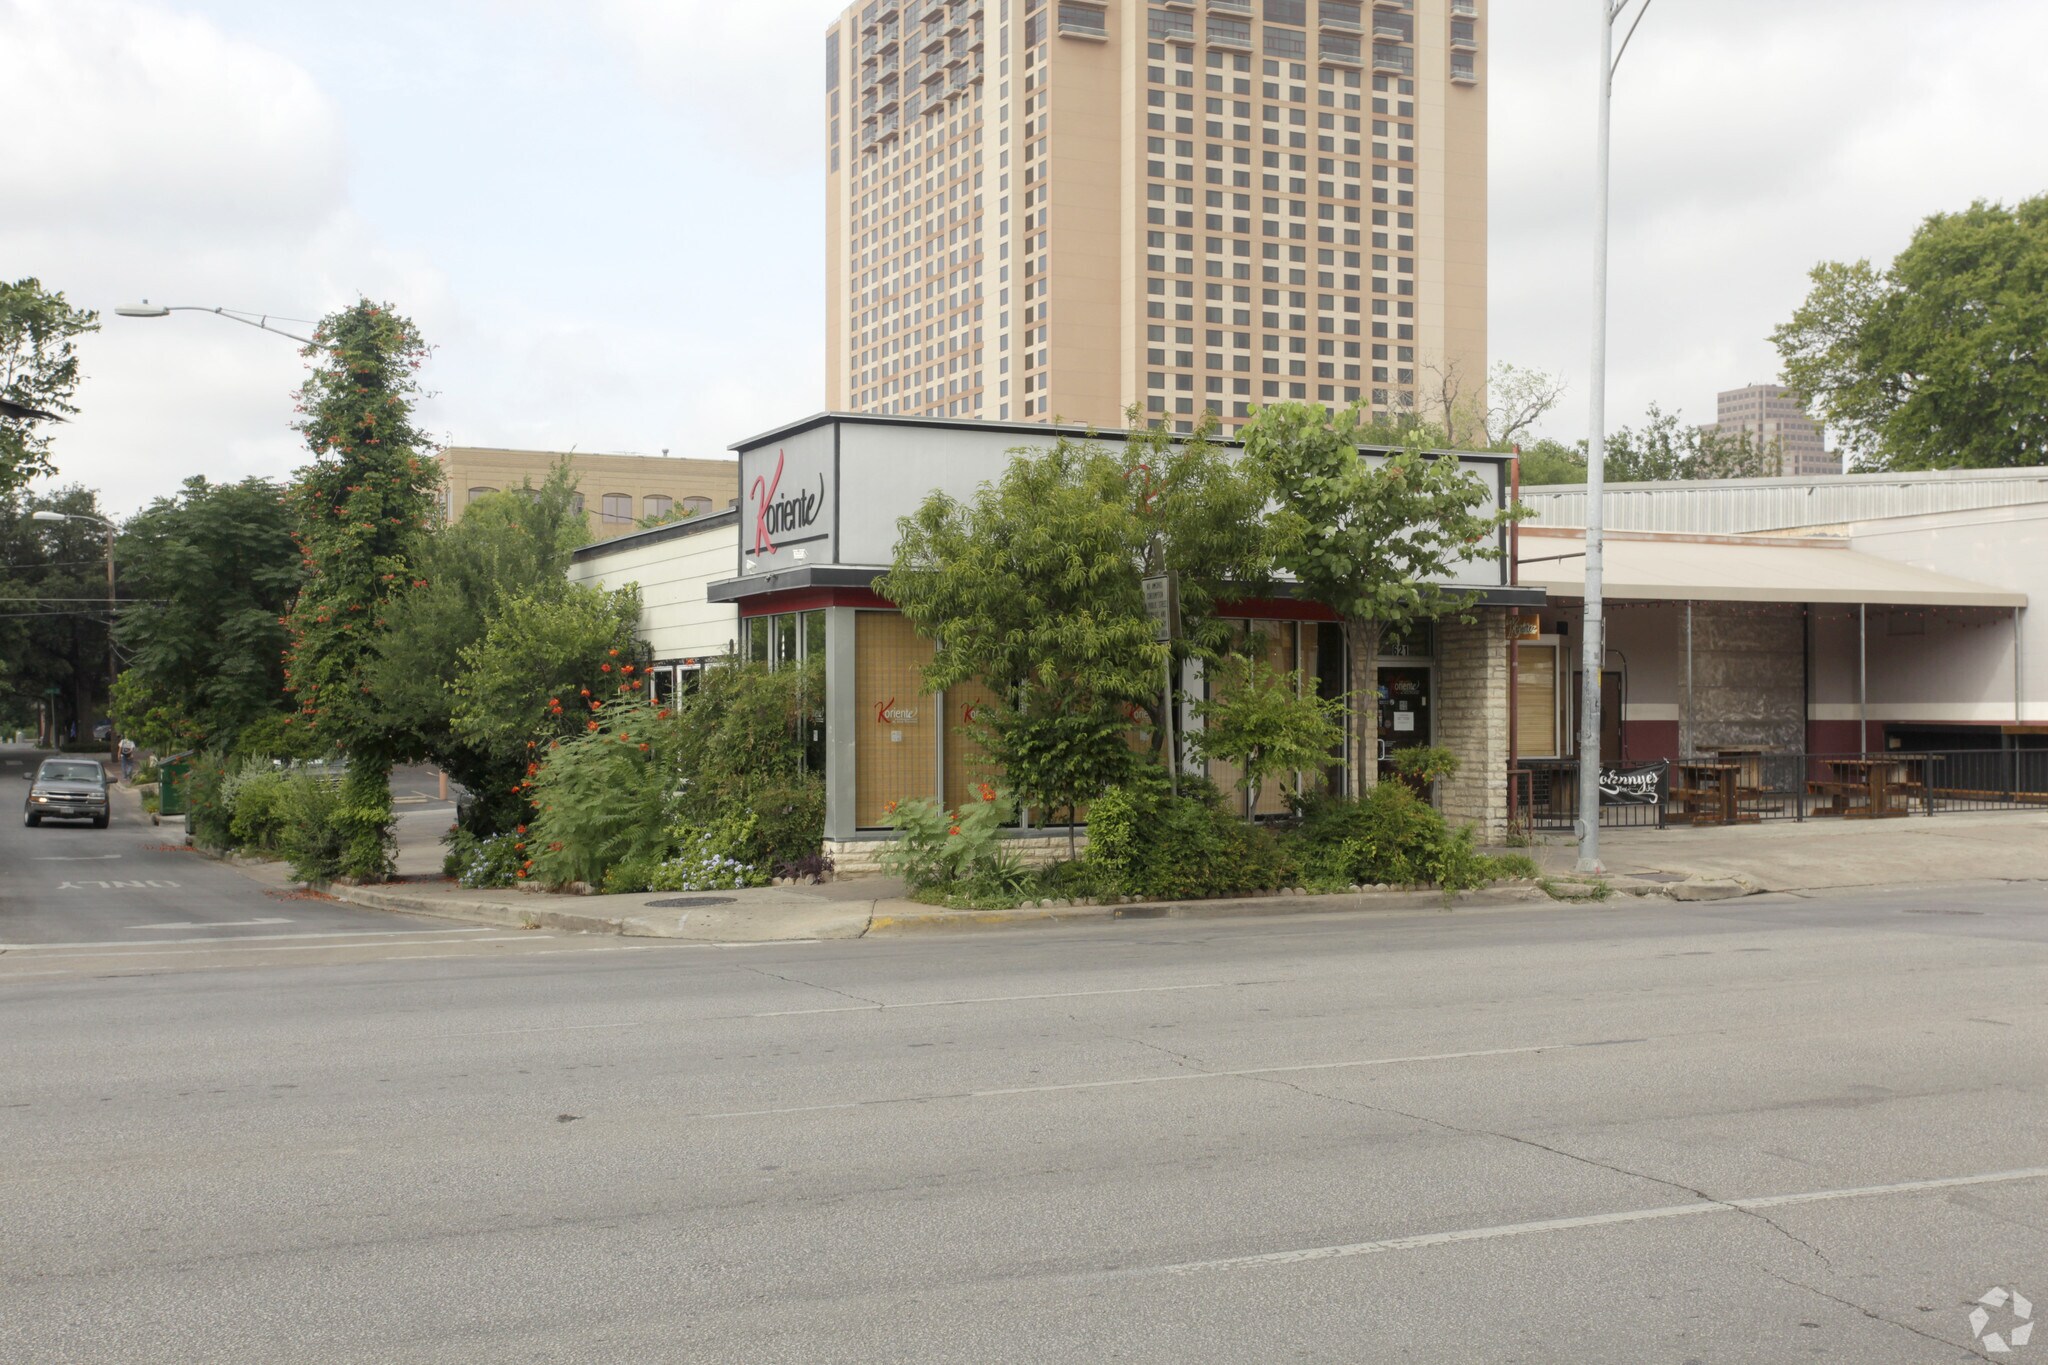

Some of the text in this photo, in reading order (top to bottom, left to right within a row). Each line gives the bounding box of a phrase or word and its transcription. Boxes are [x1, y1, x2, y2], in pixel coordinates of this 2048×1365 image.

[750, 448, 825, 557] Koriente
[1392, 645, 1408, 656] 621
[874, 696, 918, 724] Koriente
[56, 880, 181, 889] ONLY
